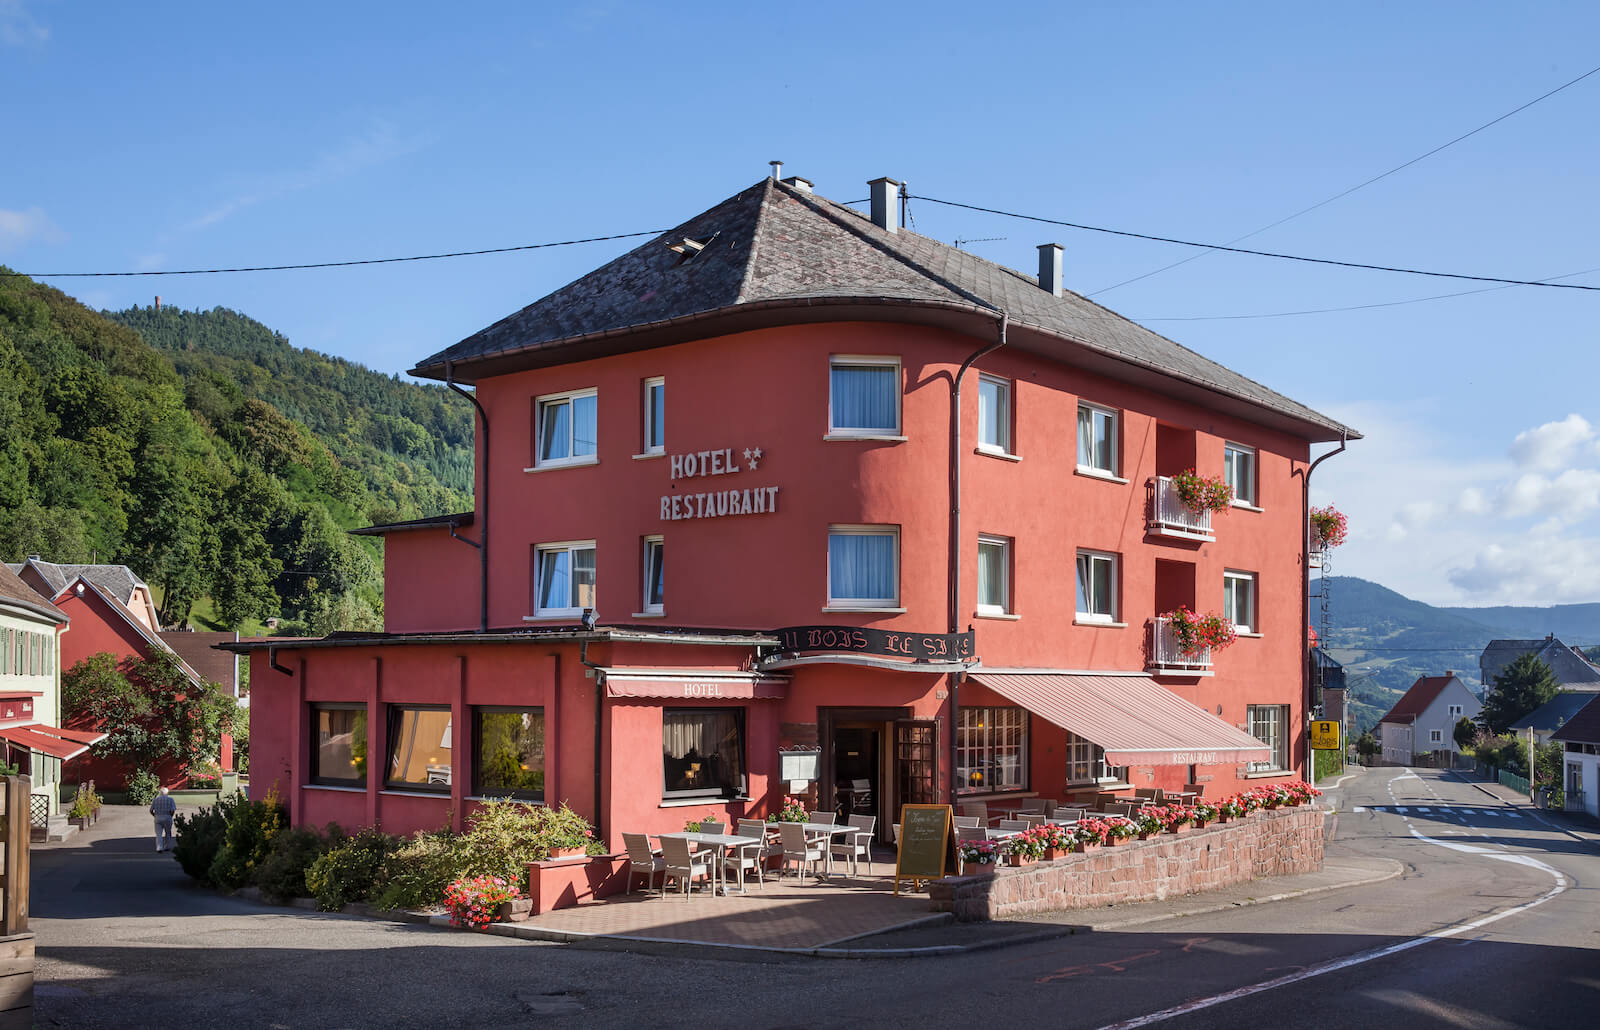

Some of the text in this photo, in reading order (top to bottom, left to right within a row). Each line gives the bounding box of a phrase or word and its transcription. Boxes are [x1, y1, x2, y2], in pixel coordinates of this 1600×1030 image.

[671, 448, 740, 480] HOTEL
[660, 485, 779, 520] RESTAURANT
[684, 683, 722, 696] HOTEL
[1173, 751, 1217, 765] RESTAURANT
